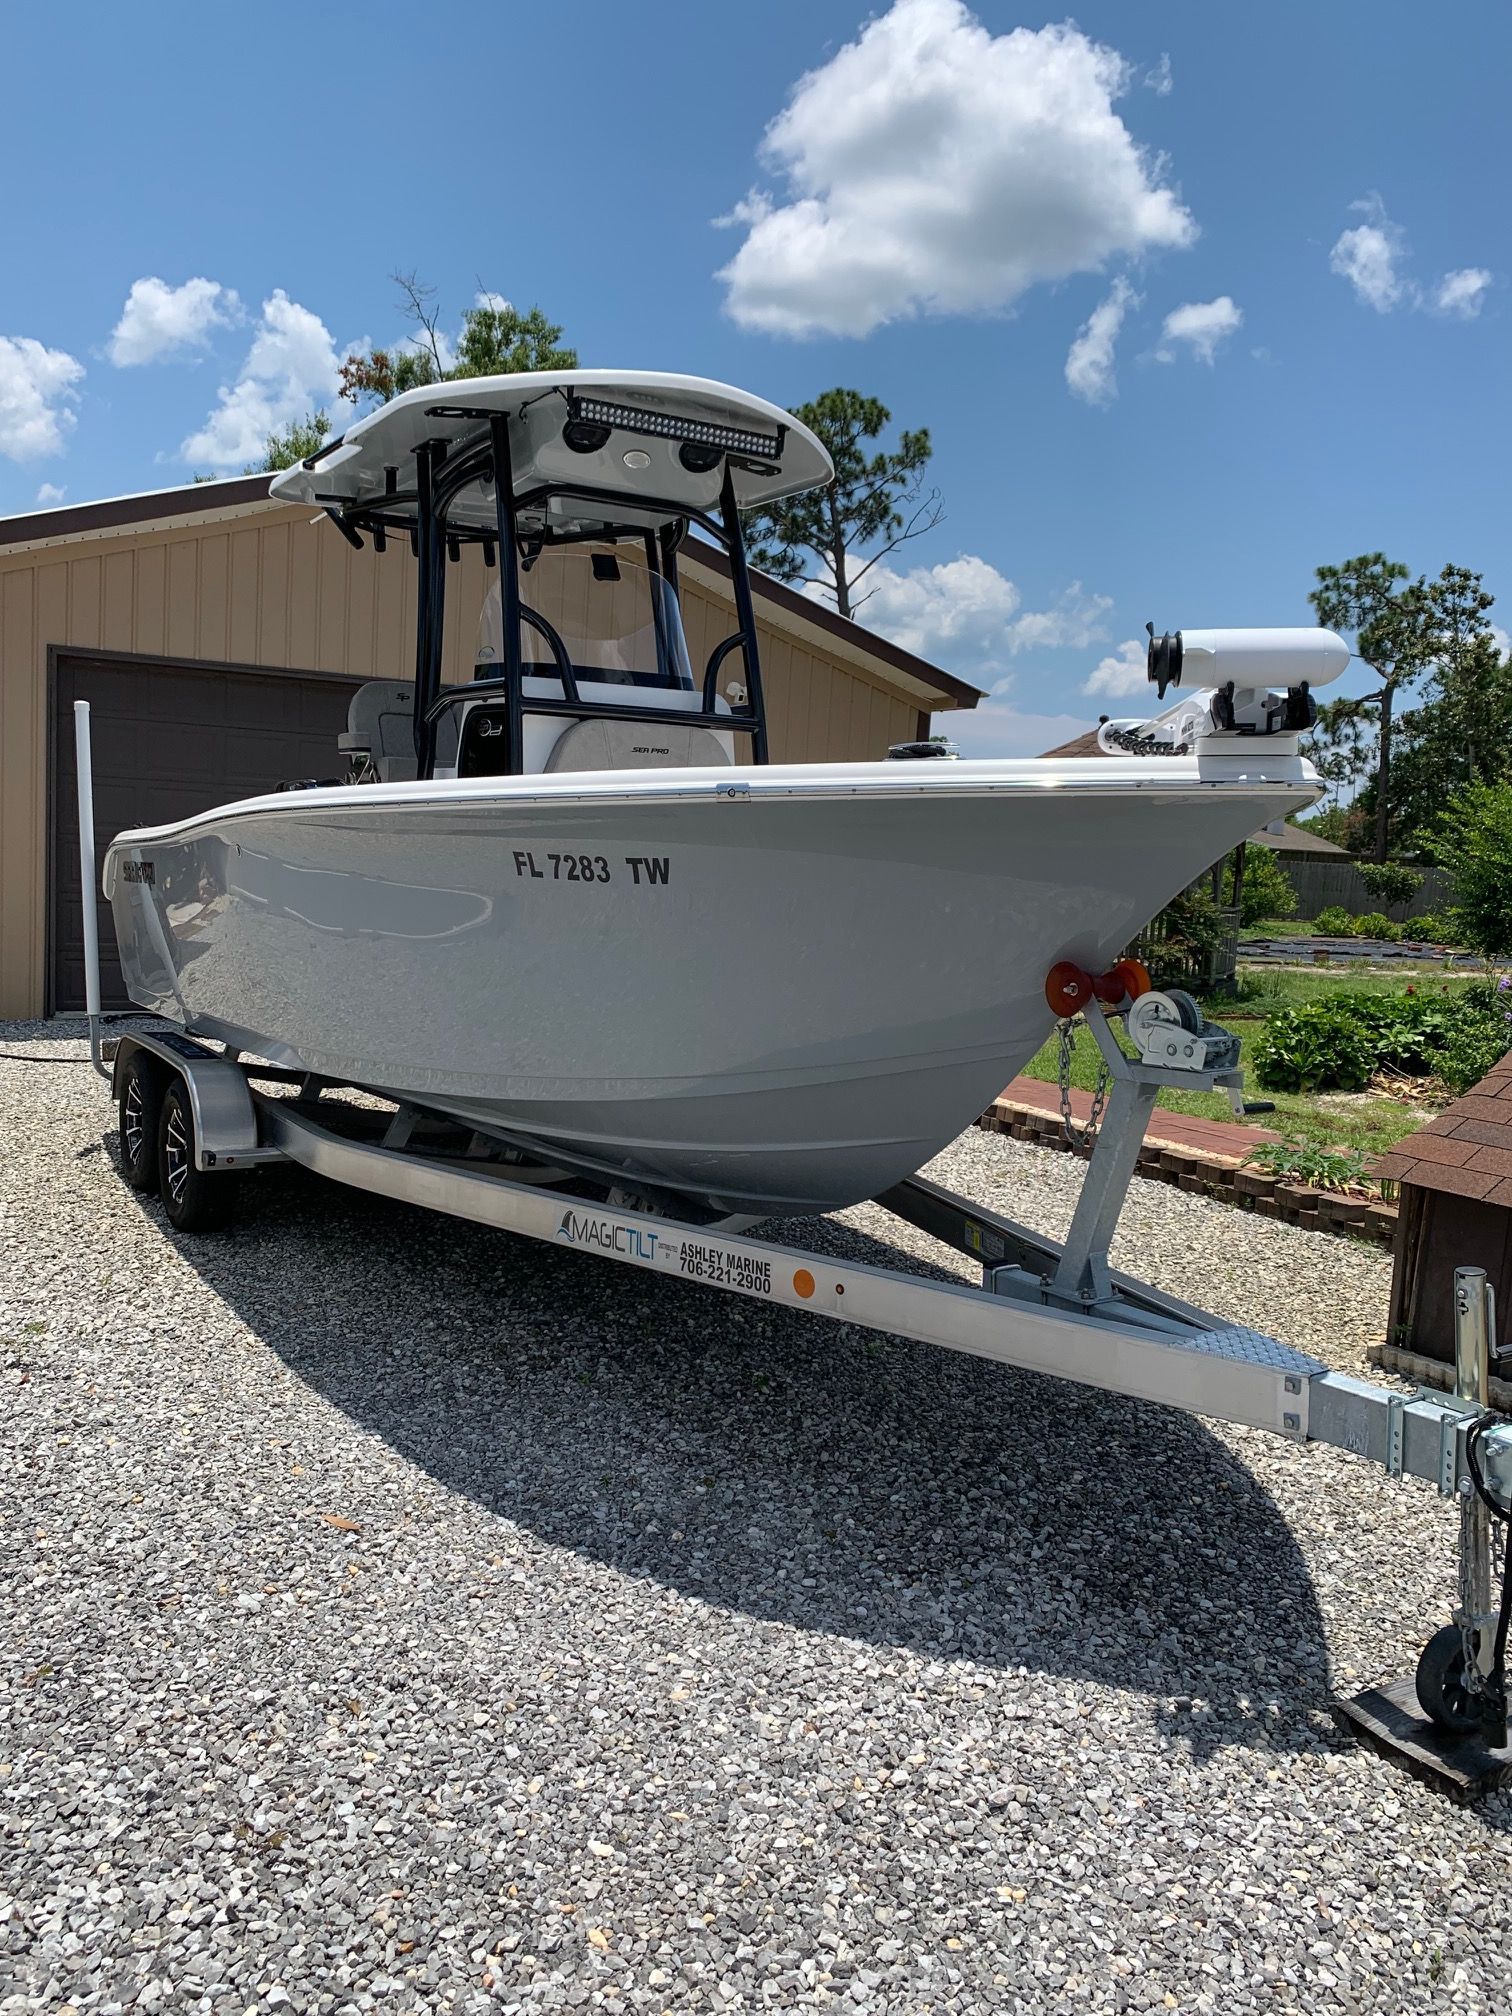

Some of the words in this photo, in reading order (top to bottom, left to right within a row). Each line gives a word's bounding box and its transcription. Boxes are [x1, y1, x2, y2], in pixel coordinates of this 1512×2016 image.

[631, 746, 650, 754] SEA
[650, 747, 670, 755] PRO
[512, 851, 544, 879] FL
[547, 853, 611, 883] 7283
[625, 857, 670, 885] TW
[572, 1215, 658, 1260] MAGICTILT
[680, 1242, 723, 1266] ASHLEY
[726, 1253, 771, 1278] MARINE
[680, 1256, 771, 1294] 706-221-2900
